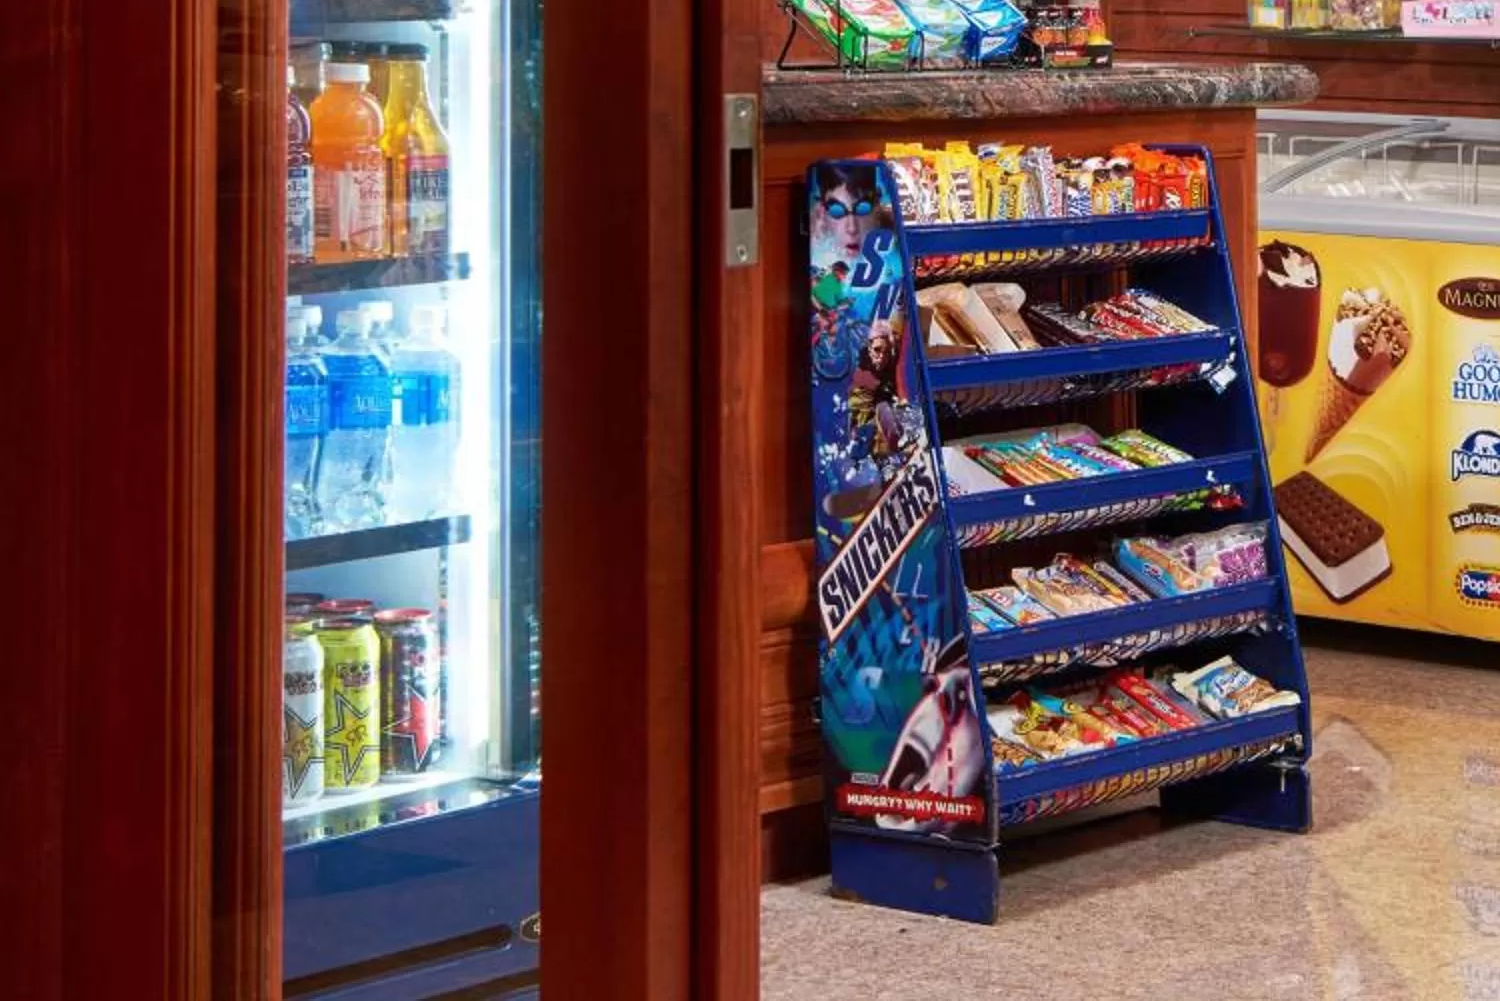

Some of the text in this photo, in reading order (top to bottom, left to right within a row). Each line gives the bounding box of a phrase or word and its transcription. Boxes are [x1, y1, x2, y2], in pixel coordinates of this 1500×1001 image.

[822, 463, 935, 630] SNICKERS
[847, 794, 903, 808] HUNGRY?
[904, 798, 933, 811] WHY
